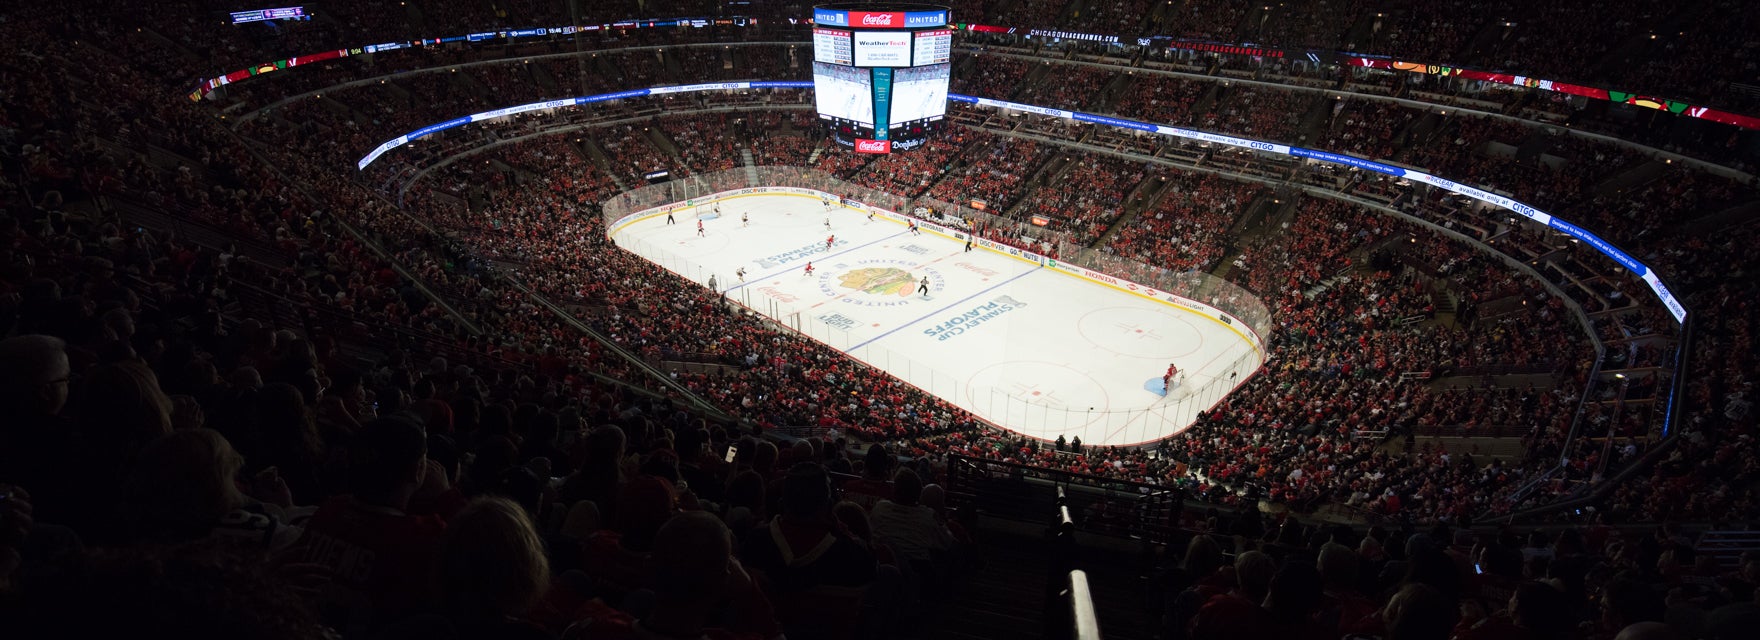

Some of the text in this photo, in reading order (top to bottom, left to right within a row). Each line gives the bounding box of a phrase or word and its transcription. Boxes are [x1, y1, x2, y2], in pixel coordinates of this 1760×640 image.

[1513, 76, 1526, 86] ONE
[1250, 142, 1273, 150] CITGO
[1459, 184, 1485, 198] available
[1487, 194, 1500, 203] only
[1512, 202, 1534, 217] CITGO
[980, 240, 1004, 251] DISCOVER
[1084, 271, 1118, 285] HONDA
[1190, 303, 1204, 311] LIGHT
[820, 315, 852, 330] LIGHT
[831, 314, 854, 324] BUD
[924, 301, 999, 336] PLAYOFFS
[938, 304, 1013, 341] STANLEY CUP
